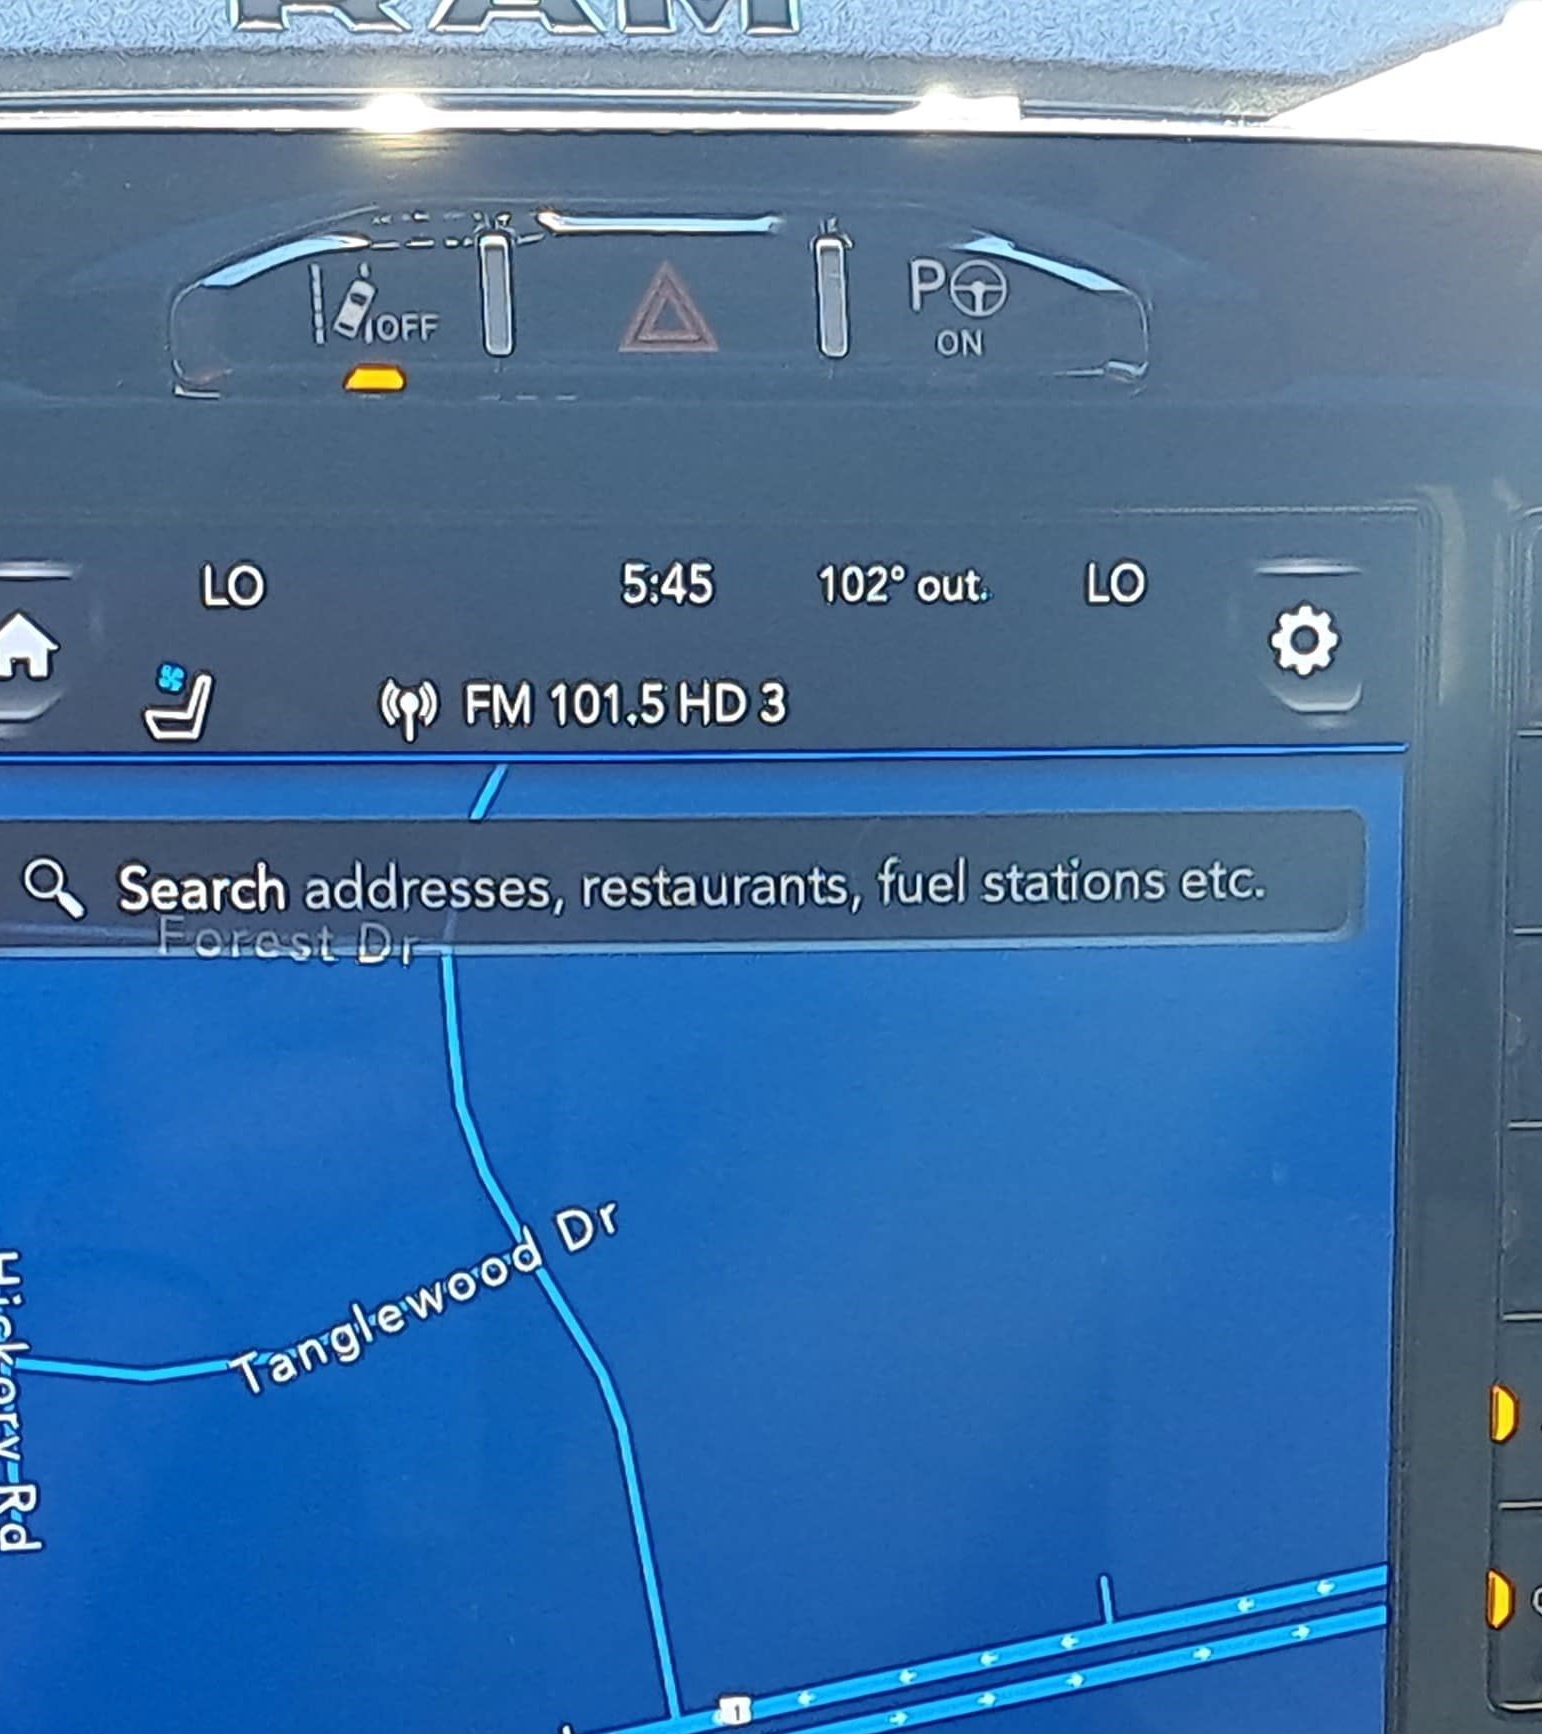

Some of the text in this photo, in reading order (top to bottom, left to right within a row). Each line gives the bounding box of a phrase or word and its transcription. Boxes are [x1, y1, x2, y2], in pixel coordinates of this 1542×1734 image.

[377, 314, 439, 343] OFF
[936, 330, 984, 358] ON
[203, 564, 265, 608] LO
[621, 562, 714, 605] 5:45
[819, 565, 993, 603] 102° out.
[1086, 562, 1147, 604] LO
[466, 682, 788, 727] FM 101.5 HD 3
[118, 856, 1266, 918] Search addresses, restaurants, fuel stations etc.
[159, 915, 421, 968] Forest Dr
[230, 1201, 618, 1395] Tanglewood Dr
